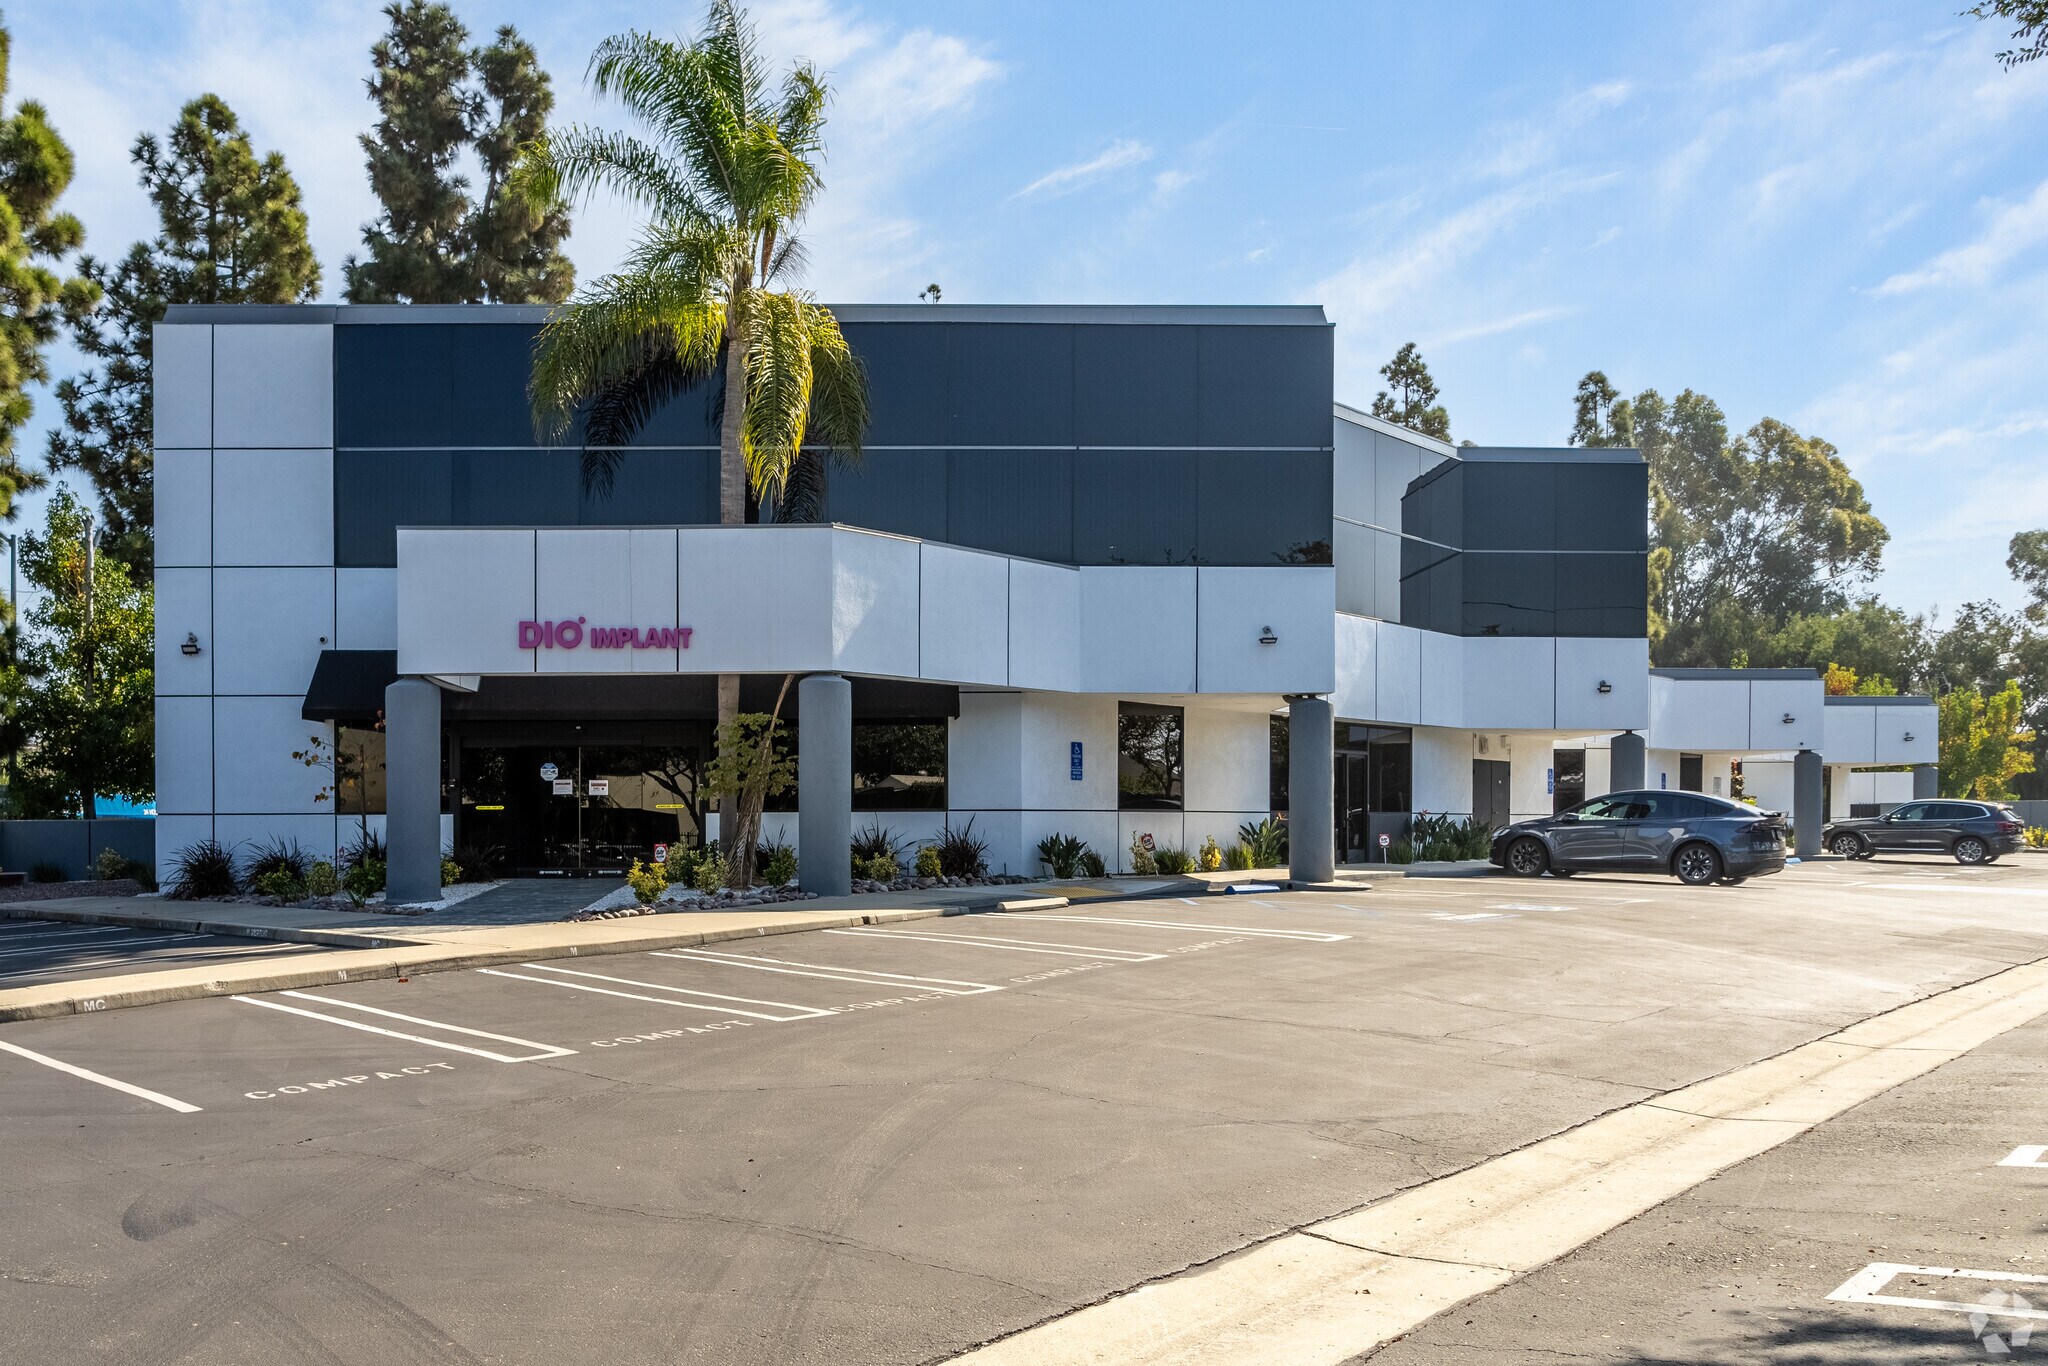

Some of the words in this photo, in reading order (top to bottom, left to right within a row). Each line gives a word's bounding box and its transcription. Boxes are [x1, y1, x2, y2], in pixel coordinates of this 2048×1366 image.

[518, 616, 586, 650] DIO
[590, 627, 693, 649] IMPLANT
[1166, 936, 1254, 954] COMPACT
[1009, 961, 1116, 984] COMPACT
[83, 999, 106, 1012] MC
[829, 991, 958, 1012] COMPACT
[590, 1019, 754, 1048] COMPACT
[244, 1062, 455, 1099] COMPACT
